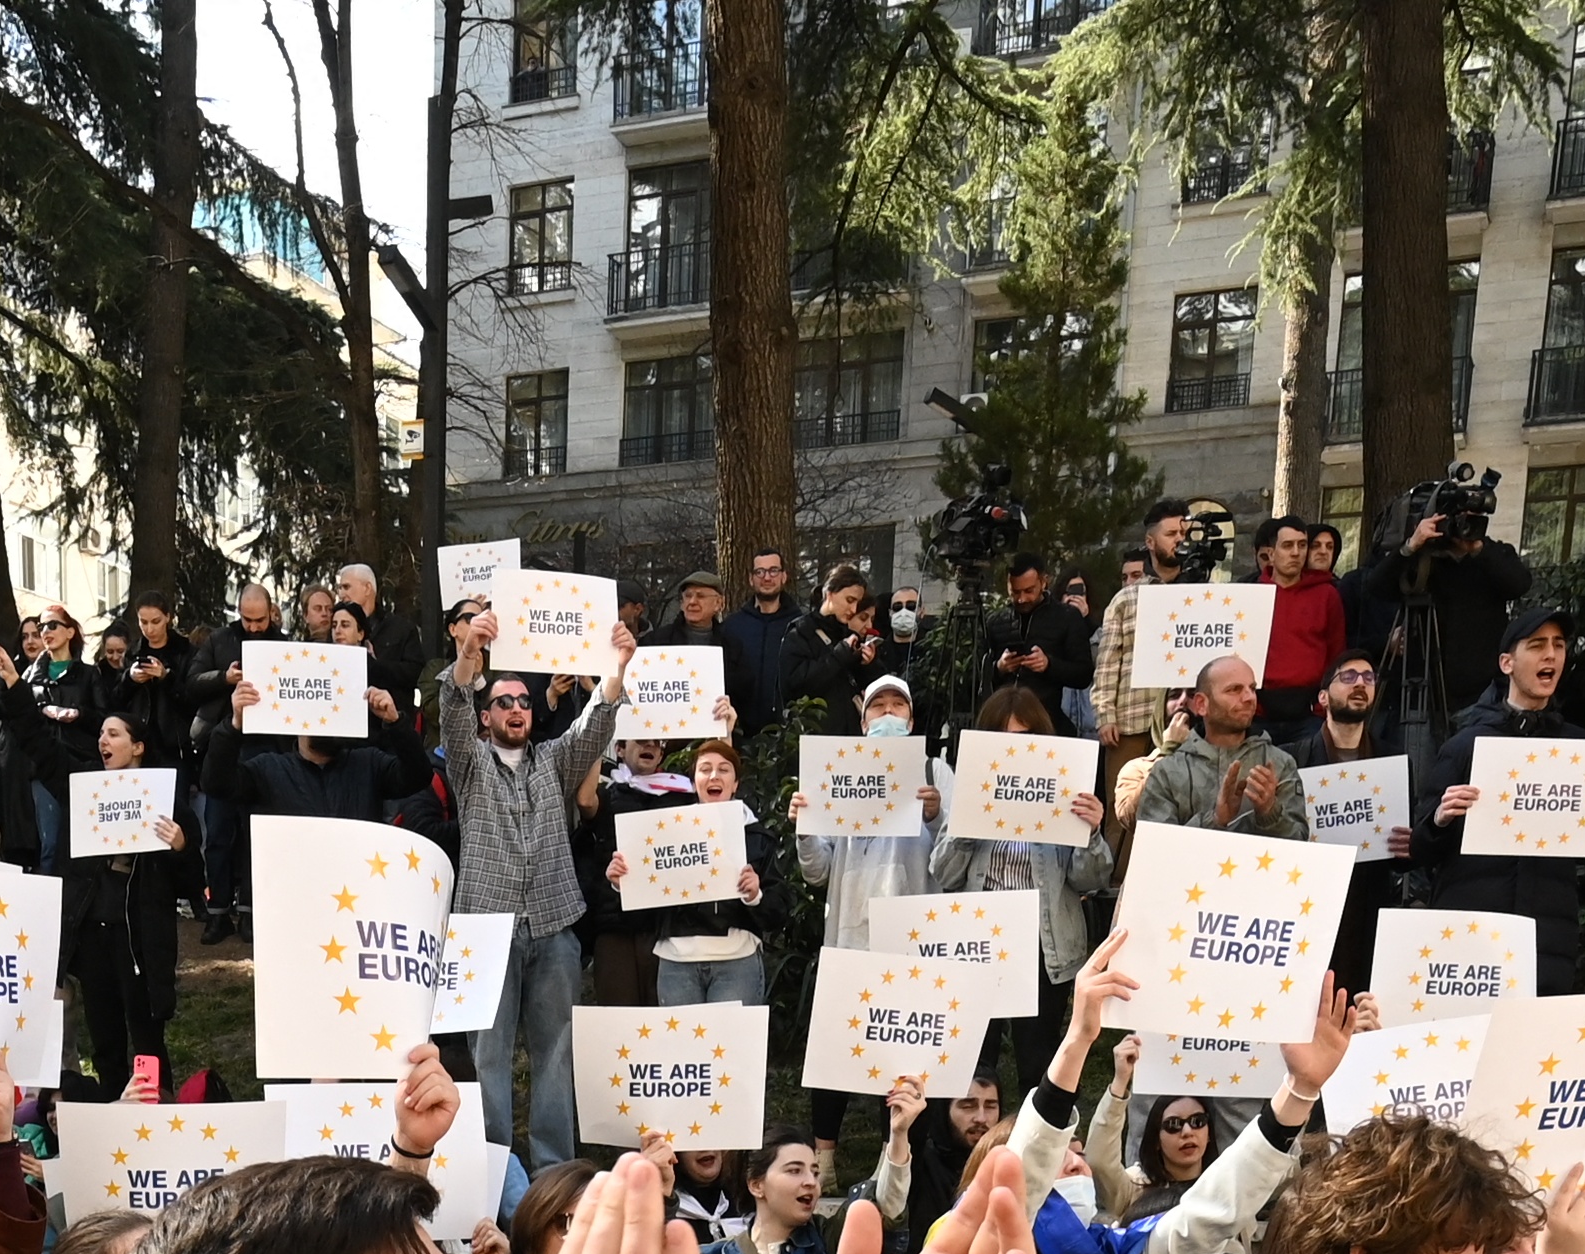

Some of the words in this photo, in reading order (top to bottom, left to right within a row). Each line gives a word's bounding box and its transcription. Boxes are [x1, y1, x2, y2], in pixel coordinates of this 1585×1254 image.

[509, 510, 604, 544] Citrus
[462, 567, 476, 575] WE
[463, 573, 492, 582] EUROP
[529, 609, 550, 621] WE
[555, 611, 582, 624] ARE
[529, 622, 583, 636] EUROPE
[1176, 624, 1199, 635] WE
[1203, 623, 1234, 635] ARE
[1174, 636, 1233, 648] EUROPE
[279, 677, 299, 688] WE
[304, 678, 331, 689] ARE
[638, 681, 658, 691] WE
[663, 681, 689, 691] ARE
[279, 689, 332, 701] EUROPE
[638, 692, 690, 703] EUROPE
[831, 775, 852, 786] WE
[857, 775, 885, 787] ARE
[997, 774, 1020, 788] WE
[1024, 777, 1056, 790] ARE
[831, 787, 886, 799] EUROPE
[994, 788, 1055, 803] EUROPE
[1516, 783, 1542, 796] WE
[1547, 784, 1582, 797] ARE
[98, 800, 142, 812] EUROPE
[1315, 803, 1338, 816] WE
[1343, 798, 1372, 813] ARE
[1513, 798, 1581, 812] EUROPE
[98, 812, 120, 822] ARE
[123, 810, 141, 820] WE
[1316, 811, 1372, 828] EUROPE
[653, 845, 675, 858] WE
[680, 842, 708, 855] ARE
[655, 854, 709, 870] EUROPE
[1198, 911, 1239, 937] WE
[1244, 918, 1295, 942] ARE
[356, 920, 409, 951] WE
[919, 943, 948, 957] WE
[954, 941, 990, 956] ARE
[1190, 937, 1290, 967] EUROPE
[358, 953, 439, 992] EUROP
[1429, 963, 1459, 979] WE
[1463, 965, 1501, 980] ARE
[1425, 980, 1500, 997] EUROPE
[869, 1007, 900, 1025] WE
[906, 1012, 946, 1029] ARE
[865, 1025, 944, 1046] EUROPE
[1182, 1037, 1250, 1052] EUROPE
[629, 1064, 662, 1080] WE
[669, 1063, 711, 1080] ARE
[629, 1082, 711, 1098] EUROPE
[1390, 1085, 1426, 1104] WE
[1434, 1079, 1472, 1100] AR
[334, 1144, 370, 1159] WE
[127, 1170, 167, 1188] WE
